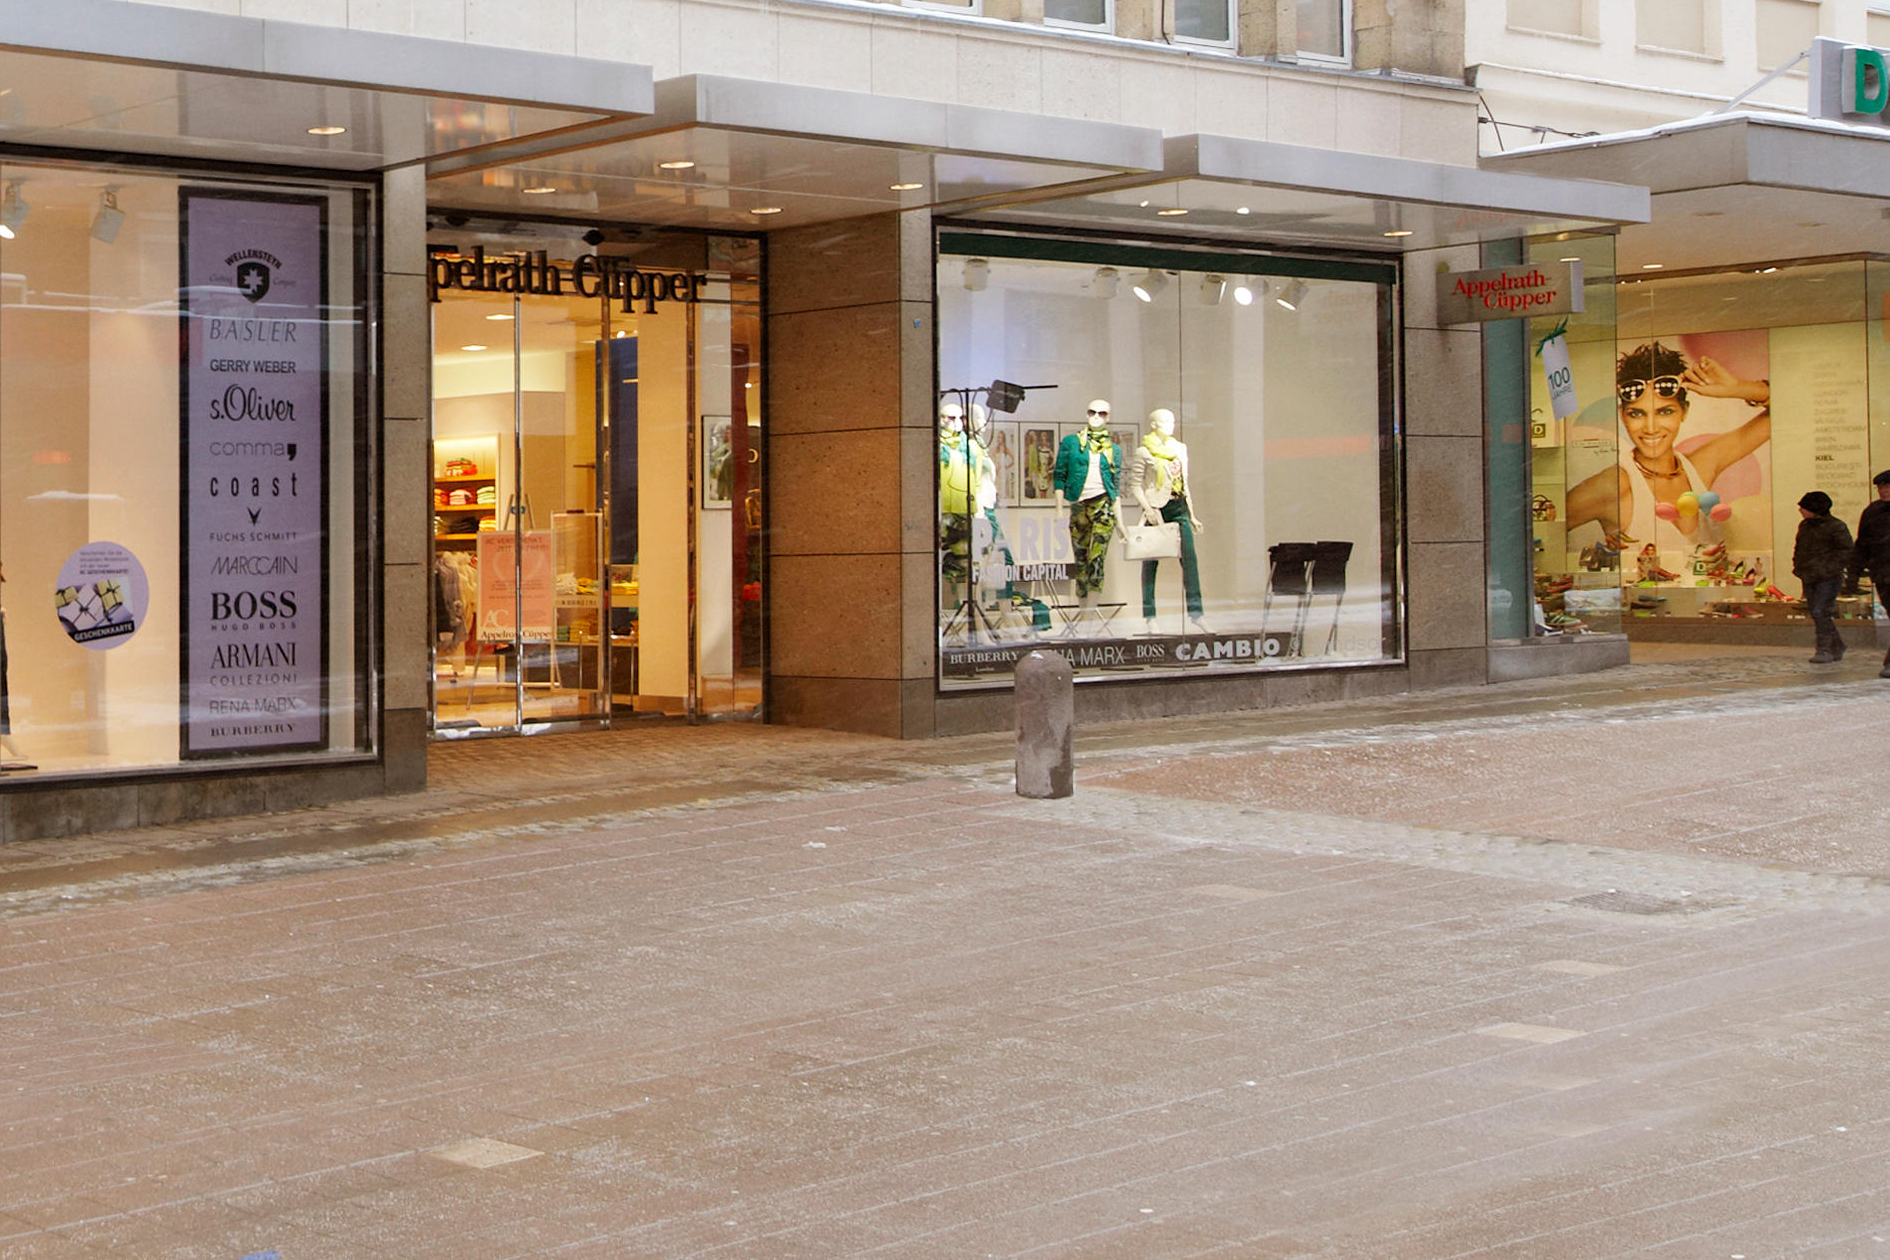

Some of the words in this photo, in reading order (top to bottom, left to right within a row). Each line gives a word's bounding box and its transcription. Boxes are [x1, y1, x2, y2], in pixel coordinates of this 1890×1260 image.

[1842, 45, 1888, 115] D
[224, 248, 283, 270] WELLENSTEYN
[1483, 290, 1557, 312] Cüpper
[210, 317, 297, 343] BASLER
[210, 358, 251, 373] GERRY
[254, 359, 297, 374] WEBER
[1548, 366, 1570, 389] 100
[210, 383, 297, 422] s.Oliver
[209, 532, 246, 542] FUCHS
[249, 531, 298, 542] SCHMITT
[1023, 563, 1070, 582] CAPITAL
[210, 590, 298, 621] BOSS
[74, 623, 133, 641] GESCHENKKARTE
[210, 623, 250, 632] HUGO
[260, 622, 297, 630] BOSS
[210, 641, 297, 669] ARMANI
[950, 650, 1019, 665] BURBERRY
[1079, 645, 1126, 666] MARX
[1136, 643, 1166, 659] BOSS
[1175, 638, 1280, 661] CAMBIO
[210, 673, 298, 687] COLLEZIONI
[210, 698, 250, 715] RENA
[210, 723, 297, 737] BURBERRY
